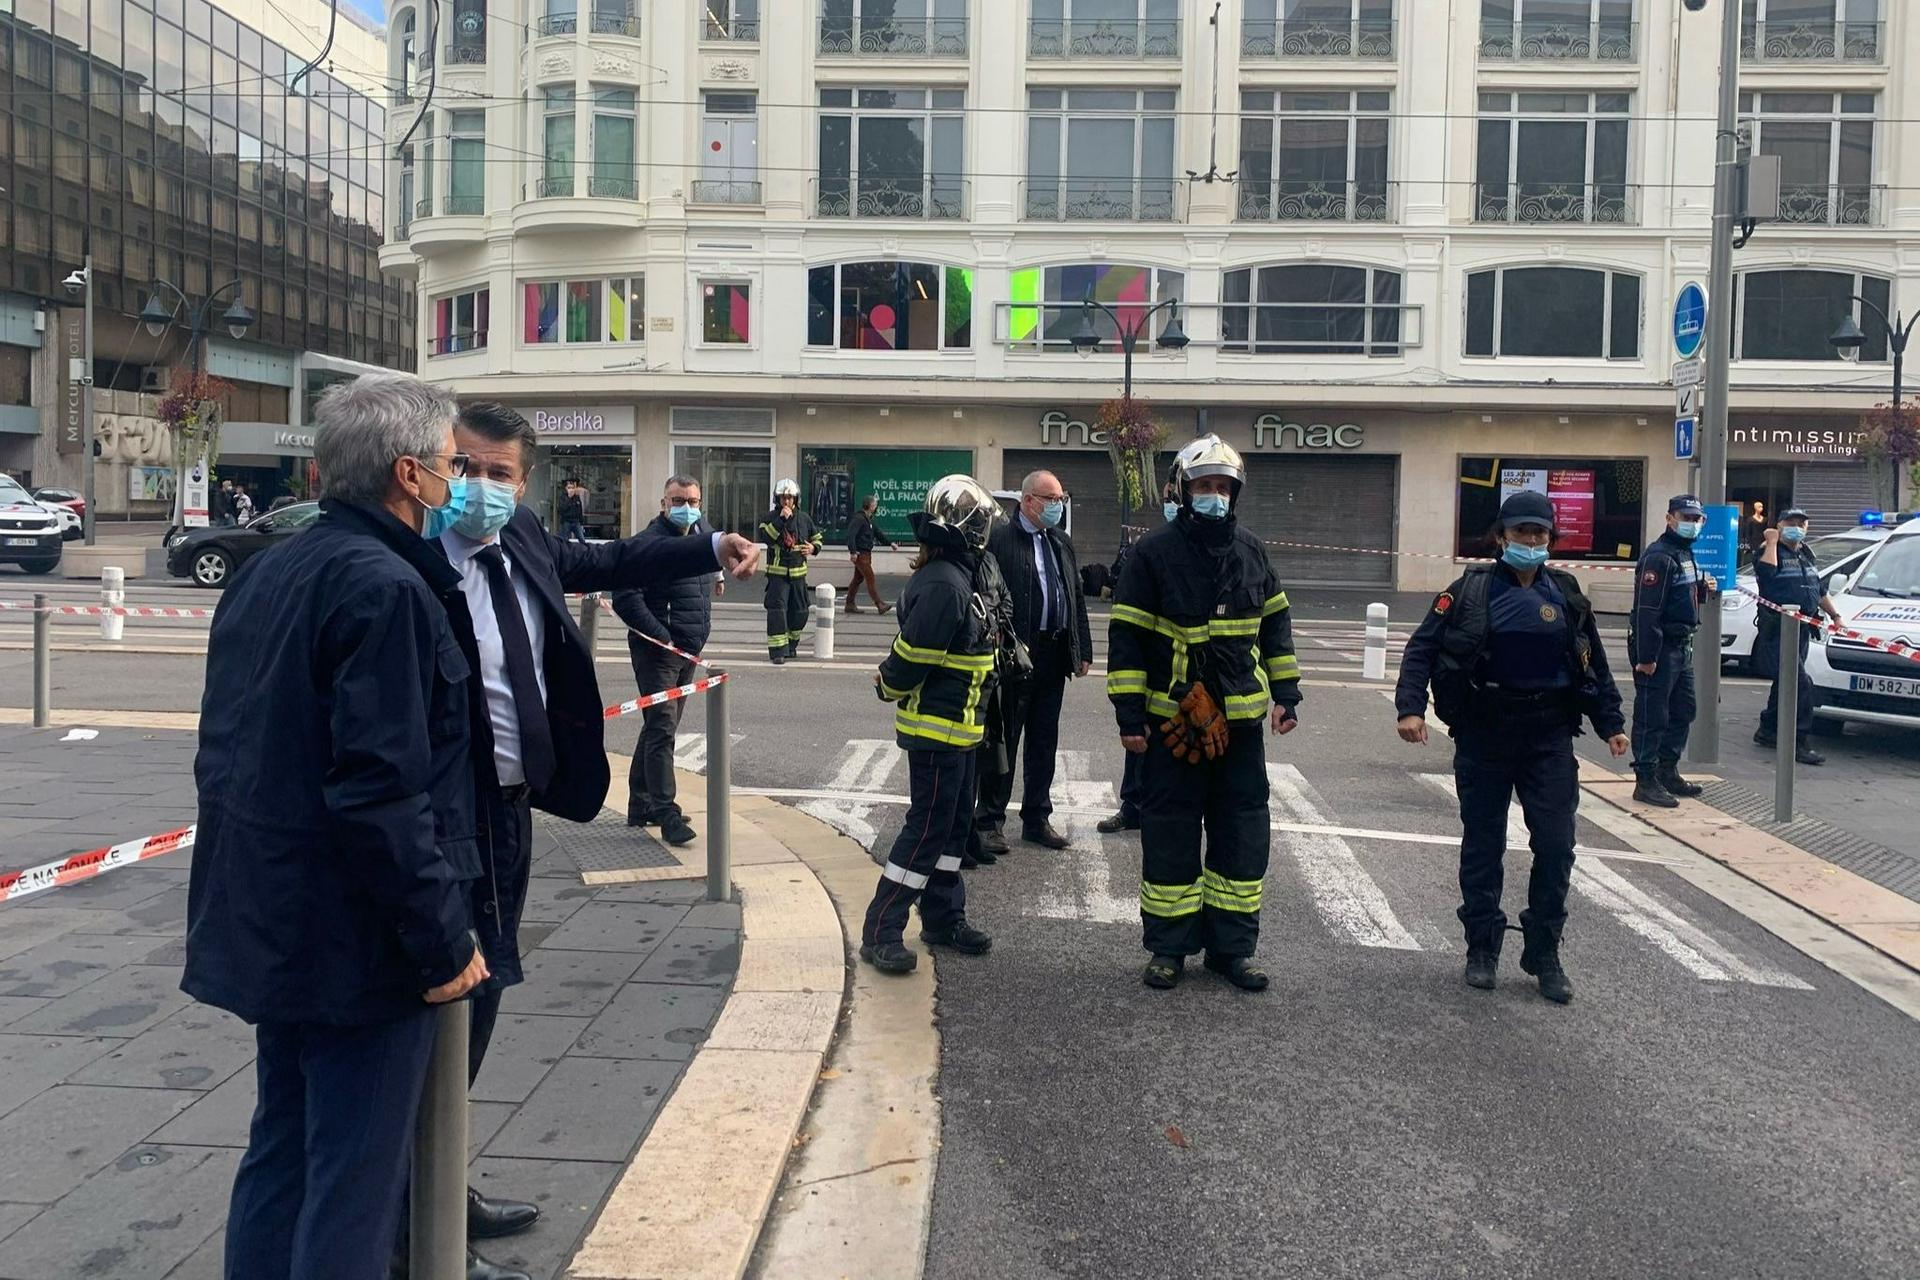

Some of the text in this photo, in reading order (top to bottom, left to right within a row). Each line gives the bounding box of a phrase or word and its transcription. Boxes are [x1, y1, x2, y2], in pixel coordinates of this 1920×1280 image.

[536, 410, 603, 431] Bershka
[1253, 413, 1364, 447] fnac
[1786, 443, 1824, 454] Italian
[873, 479, 935, 490] NOËL SE PRÉ
[883, 491, 895, 501] LA
[897, 492, 925, 501] FNAC
[33, 850, 122, 886] NATIONALE
